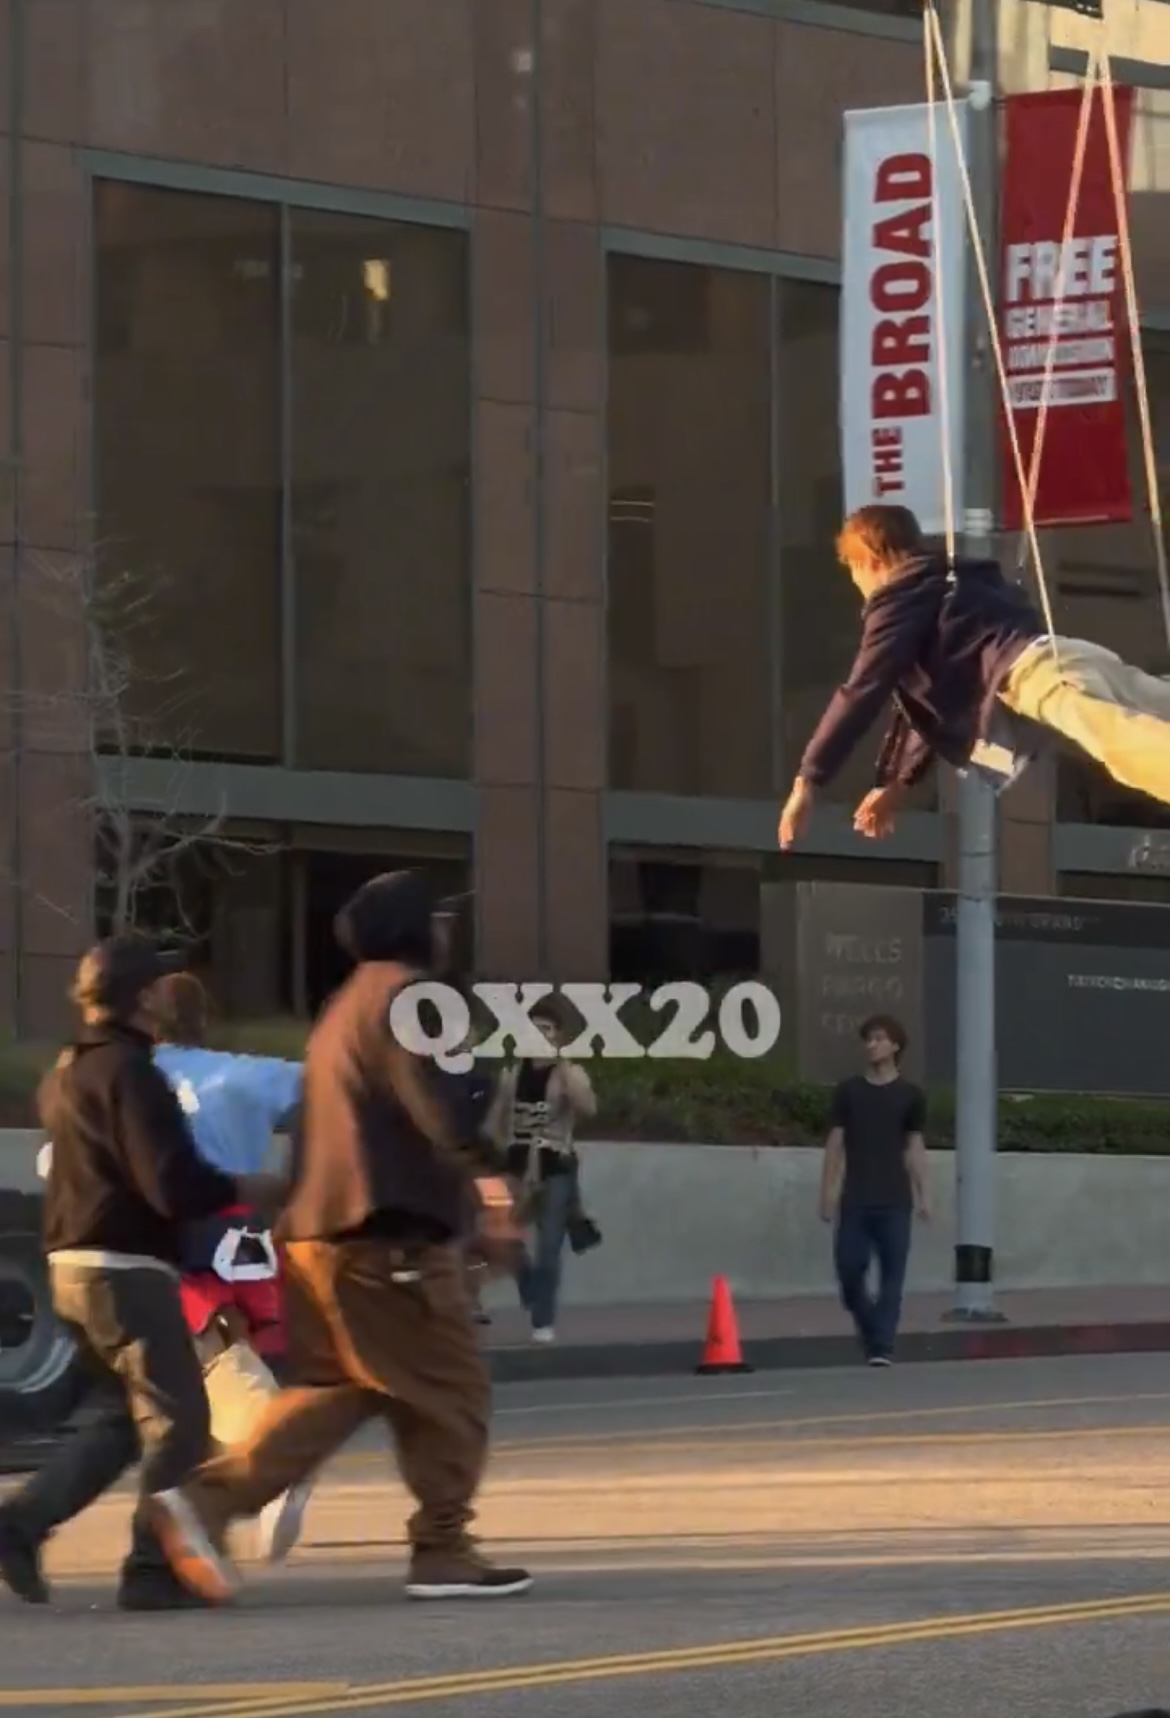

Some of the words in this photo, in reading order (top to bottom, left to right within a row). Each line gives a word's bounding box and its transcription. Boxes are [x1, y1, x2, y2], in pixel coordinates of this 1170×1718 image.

[869, 152, 933, 419] BROAD
[1007, 235, 1118, 302] FREE
[872, 426, 904, 497] THE
